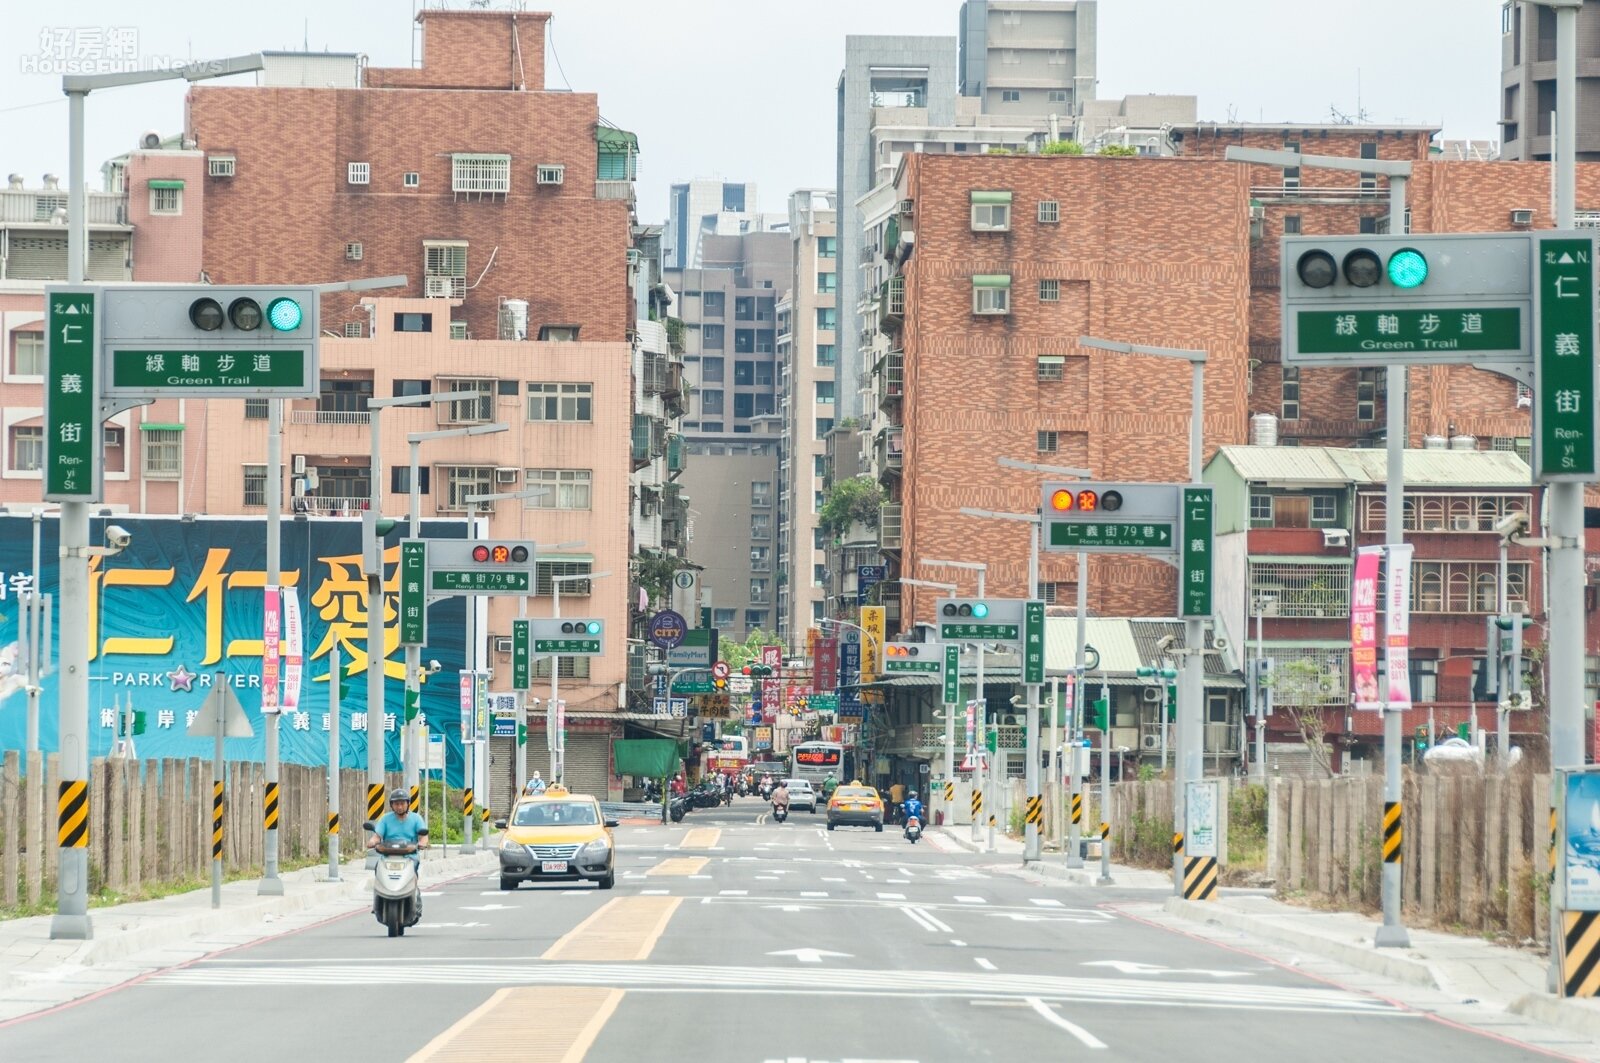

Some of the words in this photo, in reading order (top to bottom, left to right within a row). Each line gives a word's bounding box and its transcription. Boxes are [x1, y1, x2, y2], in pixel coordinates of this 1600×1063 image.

[1545, 251, 1556, 263] 北
[54, 303, 64, 315] 北
[1335, 313, 1483, 335] 綠軸步道
[1361, 339, 1414, 350] Green
[1421, 338, 1458, 349] Trail
[1554, 275, 1580, 413] 仁義街
[146, 354, 272, 373] 綠軸步道
[60, 324, 82, 443] 仁義街
[167, 376, 213, 385] Green
[219, 376, 250, 385] Trail
[1555, 428, 1584, 439] Ren-
[1565, 443, 1575, 455] yi
[59, 455, 83, 465] Ren-
[1561, 457, 1577, 469] St.
[66, 468, 75, 479] yi
[64, 480, 77, 490] St.
[1066, 525, 1155, 538] 仁義街79巷
[1190, 508, 1206, 583] 仁義街
[446, 573, 516, 584] 仁義街79巷
[407, 557, 420, 618] 仁義街
[654, 628, 681, 637] CITY
[113, 671, 164, 687] PARK
[200, 672, 260, 687] RVER
